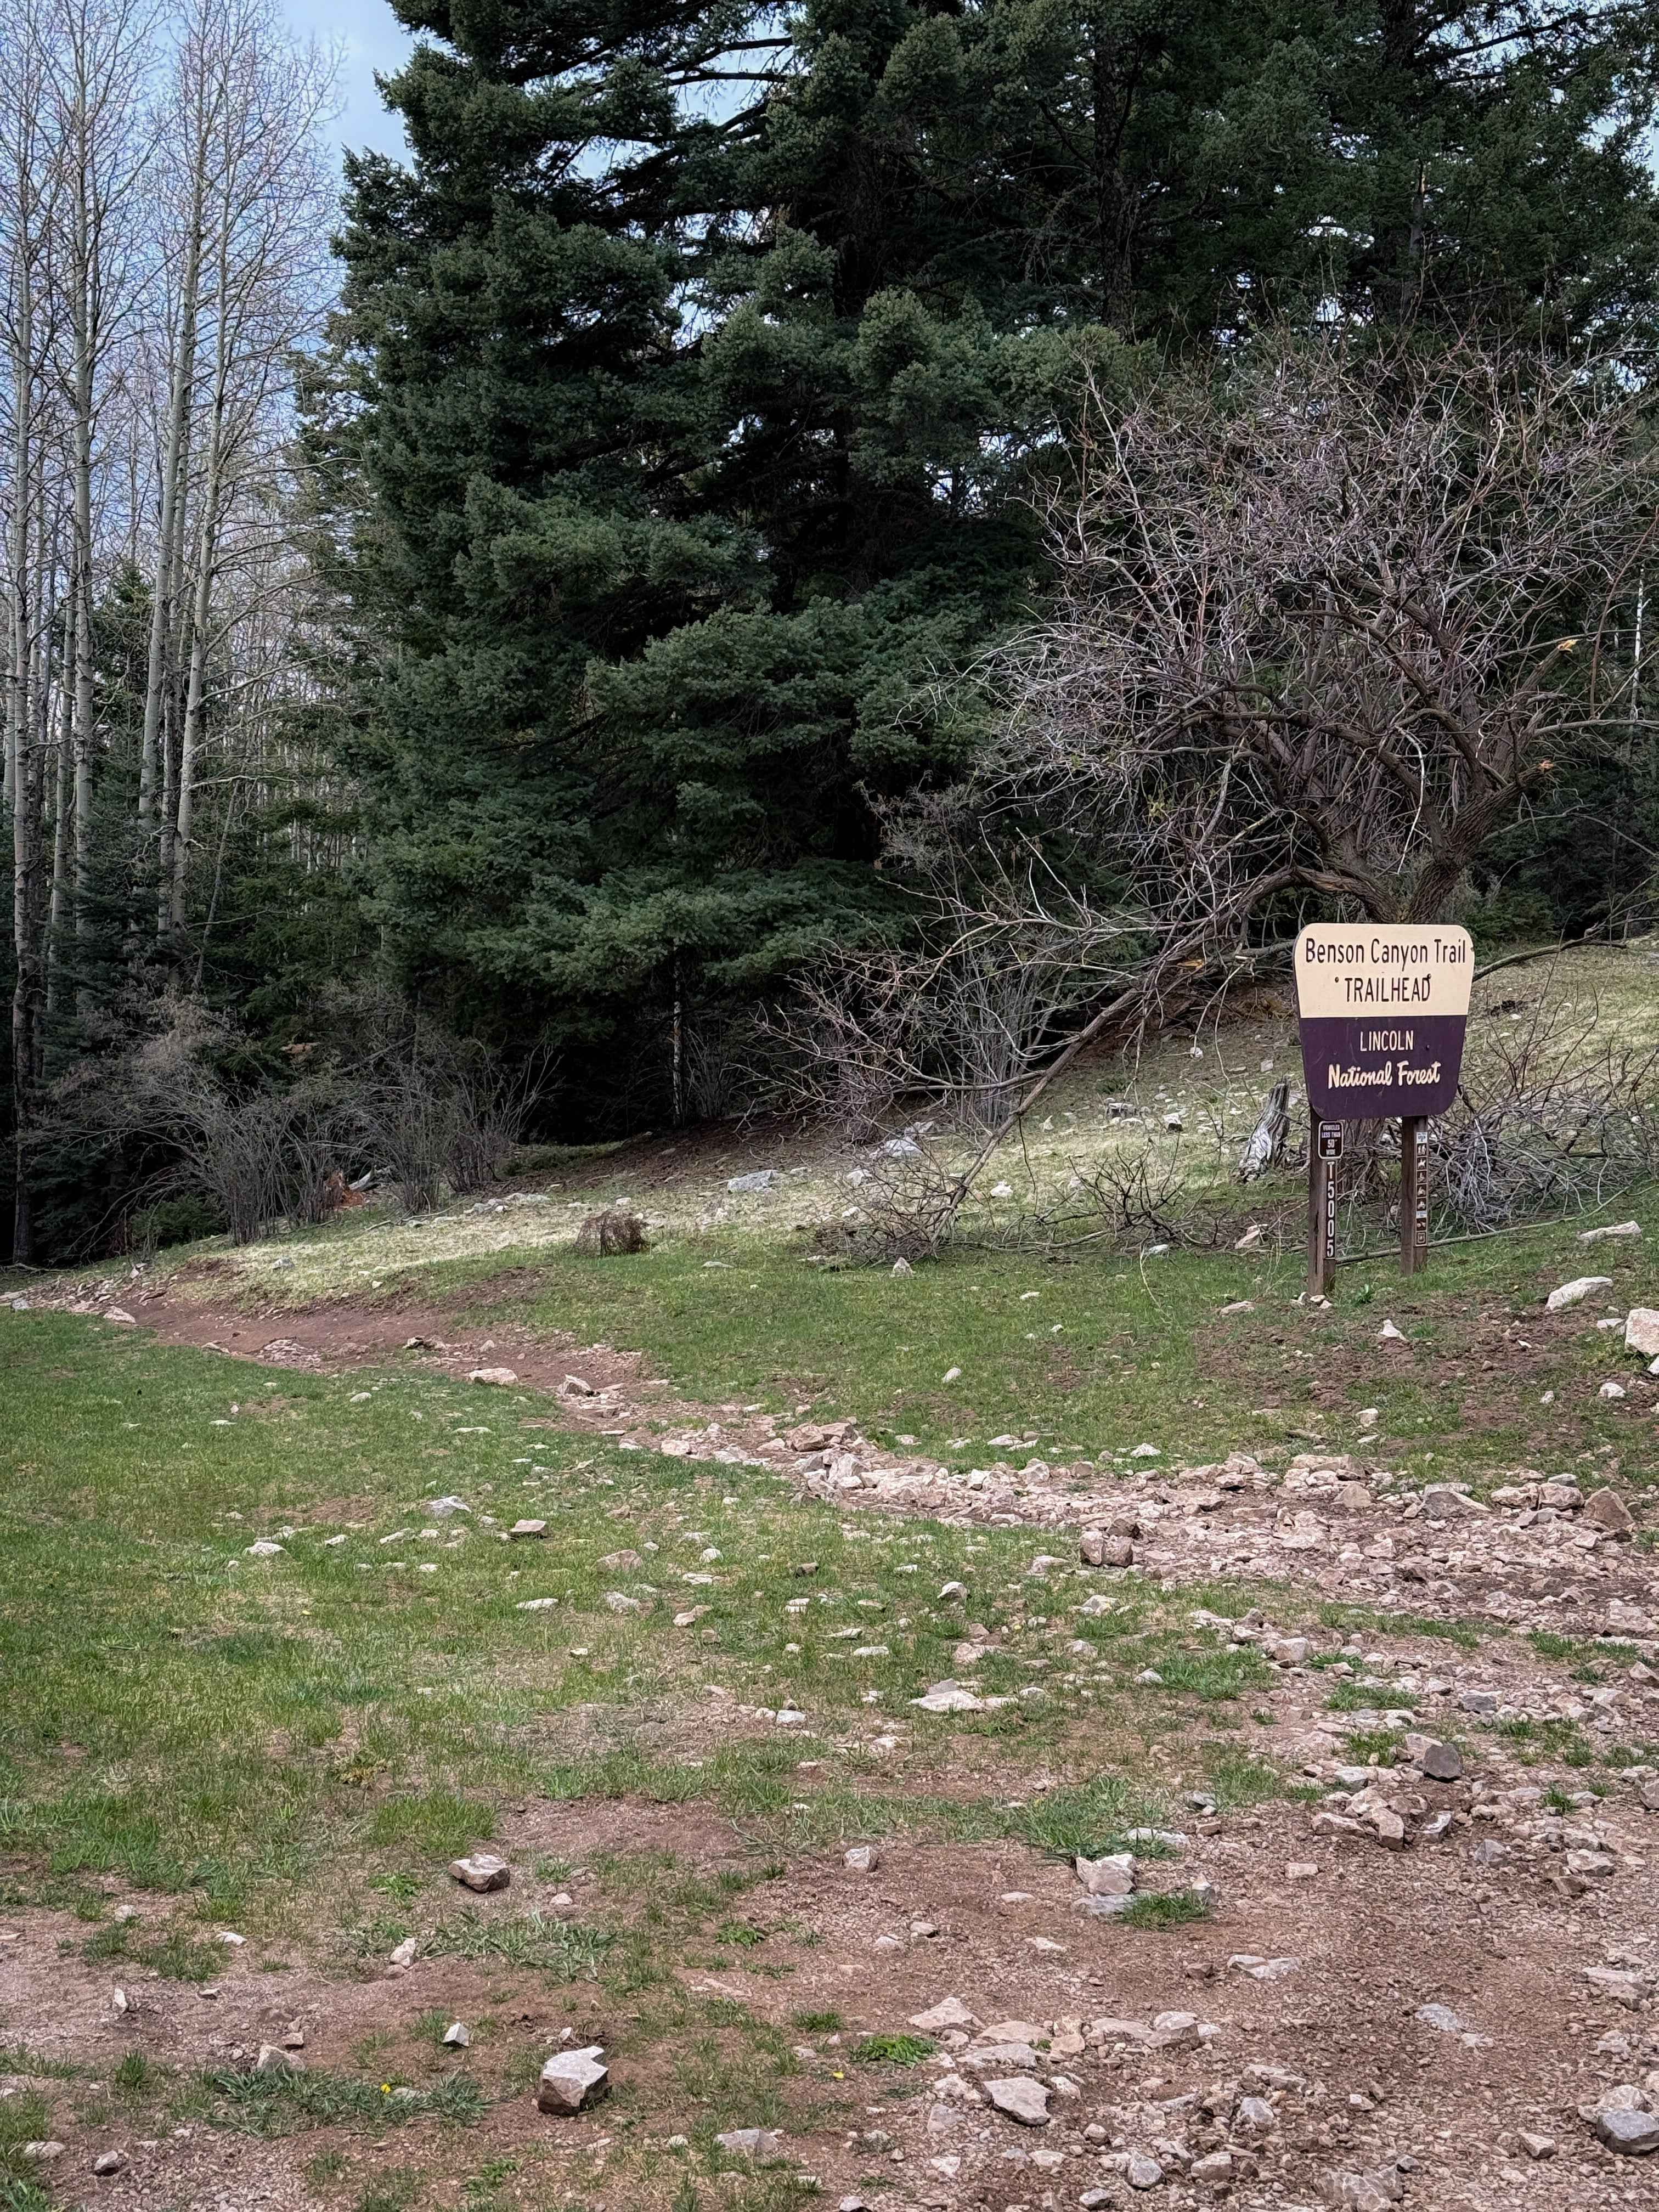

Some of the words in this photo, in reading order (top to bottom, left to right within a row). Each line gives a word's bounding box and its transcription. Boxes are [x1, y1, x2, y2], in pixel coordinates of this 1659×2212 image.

[1305, 938, 1364, 963] Benson
[1371, 938, 1427, 972] Canyon
[1434, 939, 1466, 963] Trail
[1345, 977, 1431, 1002] TRAILHEAD
[1360, 1030, 1414, 1052] LINCOLN
[1328, 1060, 1393, 1089] National
[1396, 1060, 1442, 1086] Forest
